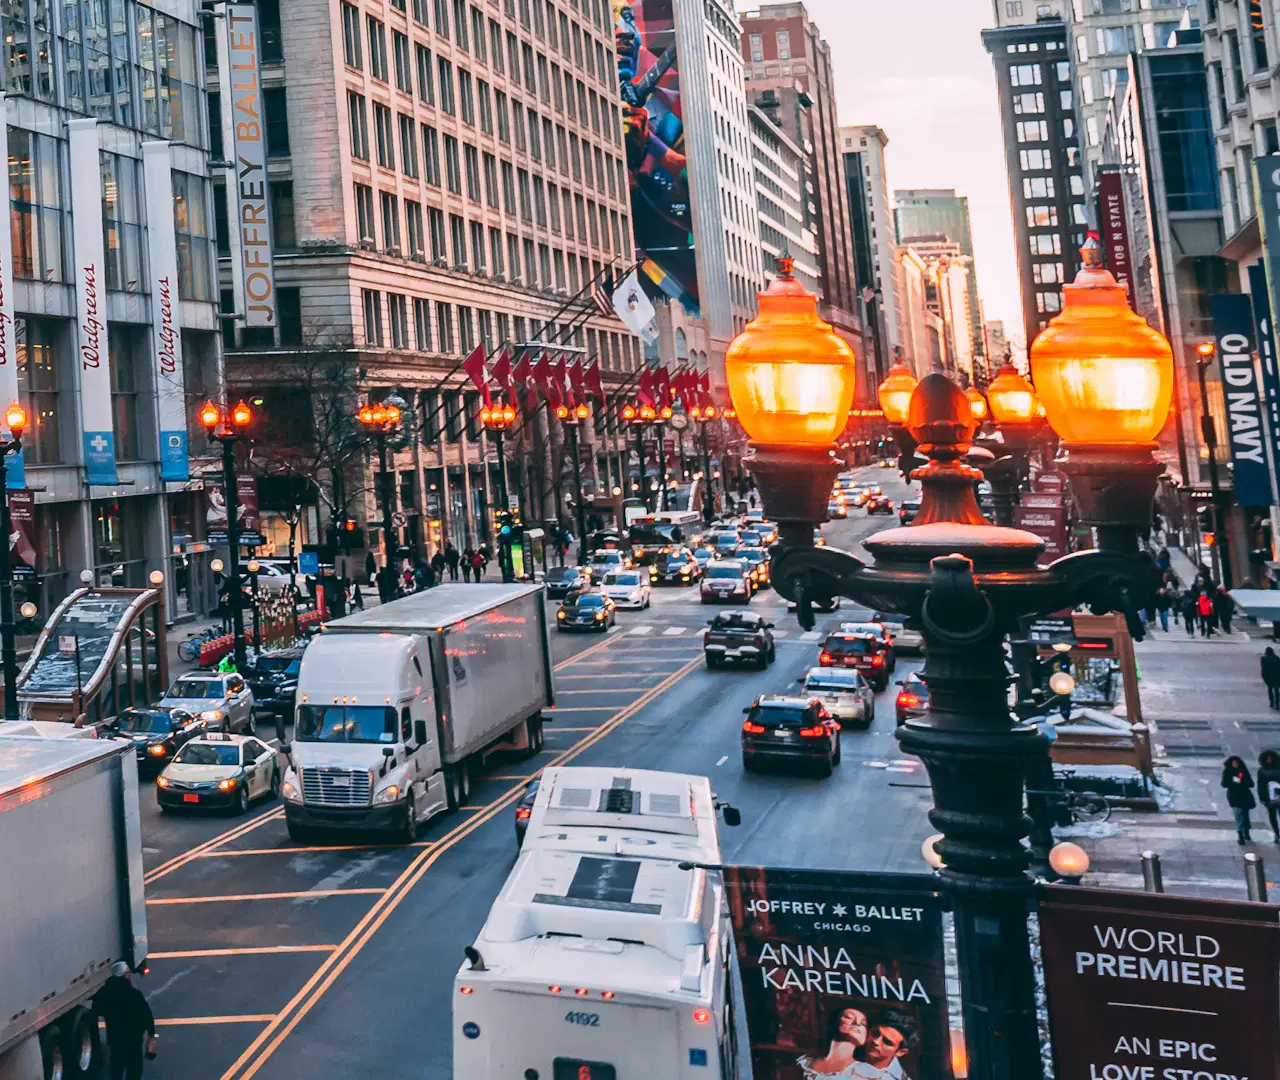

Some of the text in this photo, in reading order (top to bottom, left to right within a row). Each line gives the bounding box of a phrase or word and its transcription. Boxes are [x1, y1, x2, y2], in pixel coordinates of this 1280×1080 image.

[229, 9, 273, 322] JOFFREY BALLET
[1107, 195, 1122, 228] STATE
[1114, 245, 1125, 265] 108
[81, 263, 104, 371] Walgreens
[158, 276, 179, 376] Walgreens
[1220, 333, 1265, 464] OLD NAVY
[747, 899, 924, 921] JOFFREY BALLET
[814, 921, 871, 933] CHICAGO
[1094, 925, 1220, 958] WORLD
[758, 942, 856, 970] ANNA
[1075, 951, 1246, 991] PREMIERE
[761, 966, 931, 1004] KARENINA
[565, 1011, 600, 1027] 4192
[1114, 1035, 1217, 1062] AN EPIC
